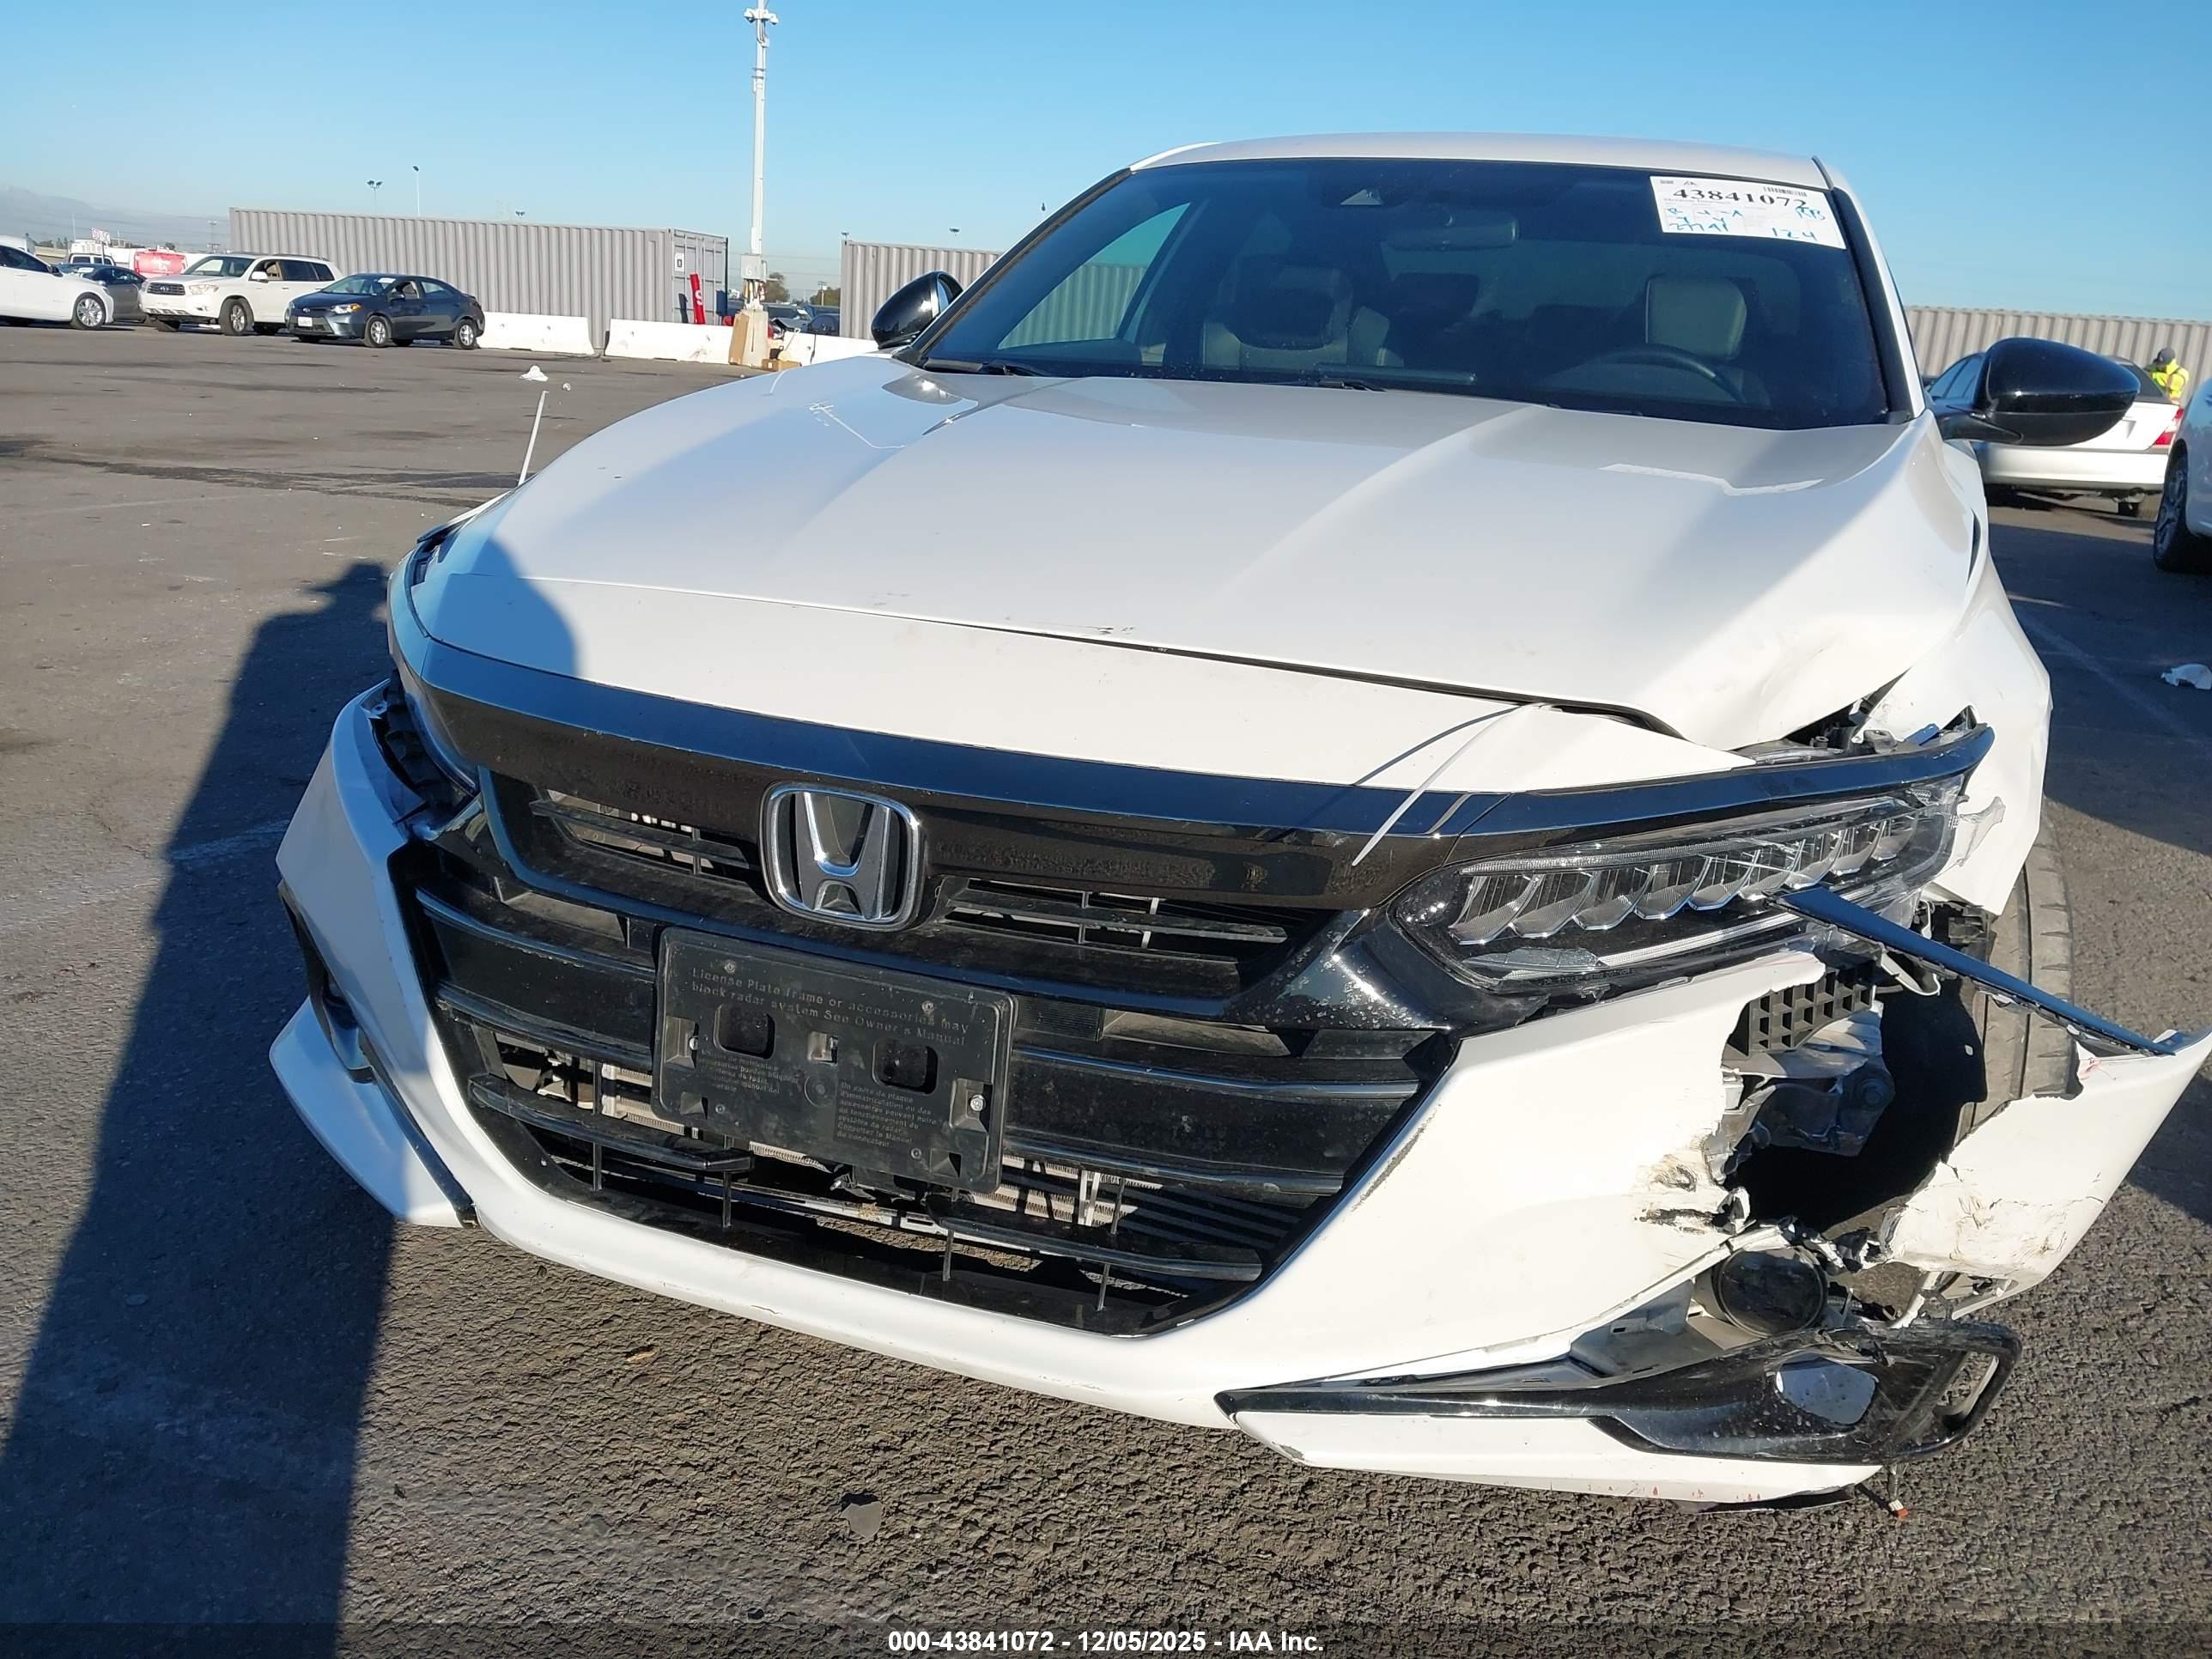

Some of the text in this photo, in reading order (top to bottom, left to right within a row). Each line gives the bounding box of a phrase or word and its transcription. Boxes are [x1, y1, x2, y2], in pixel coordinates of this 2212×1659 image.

[1674, 188, 1809, 210] 43841072
[692, 980, 727, 998] block
[730, 991, 764, 1006] radar
[692, 967, 743, 988] License
[748, 978, 781, 994] Plate
[828, 997, 845, 1009] or
[941, 1016, 969, 1034] may
